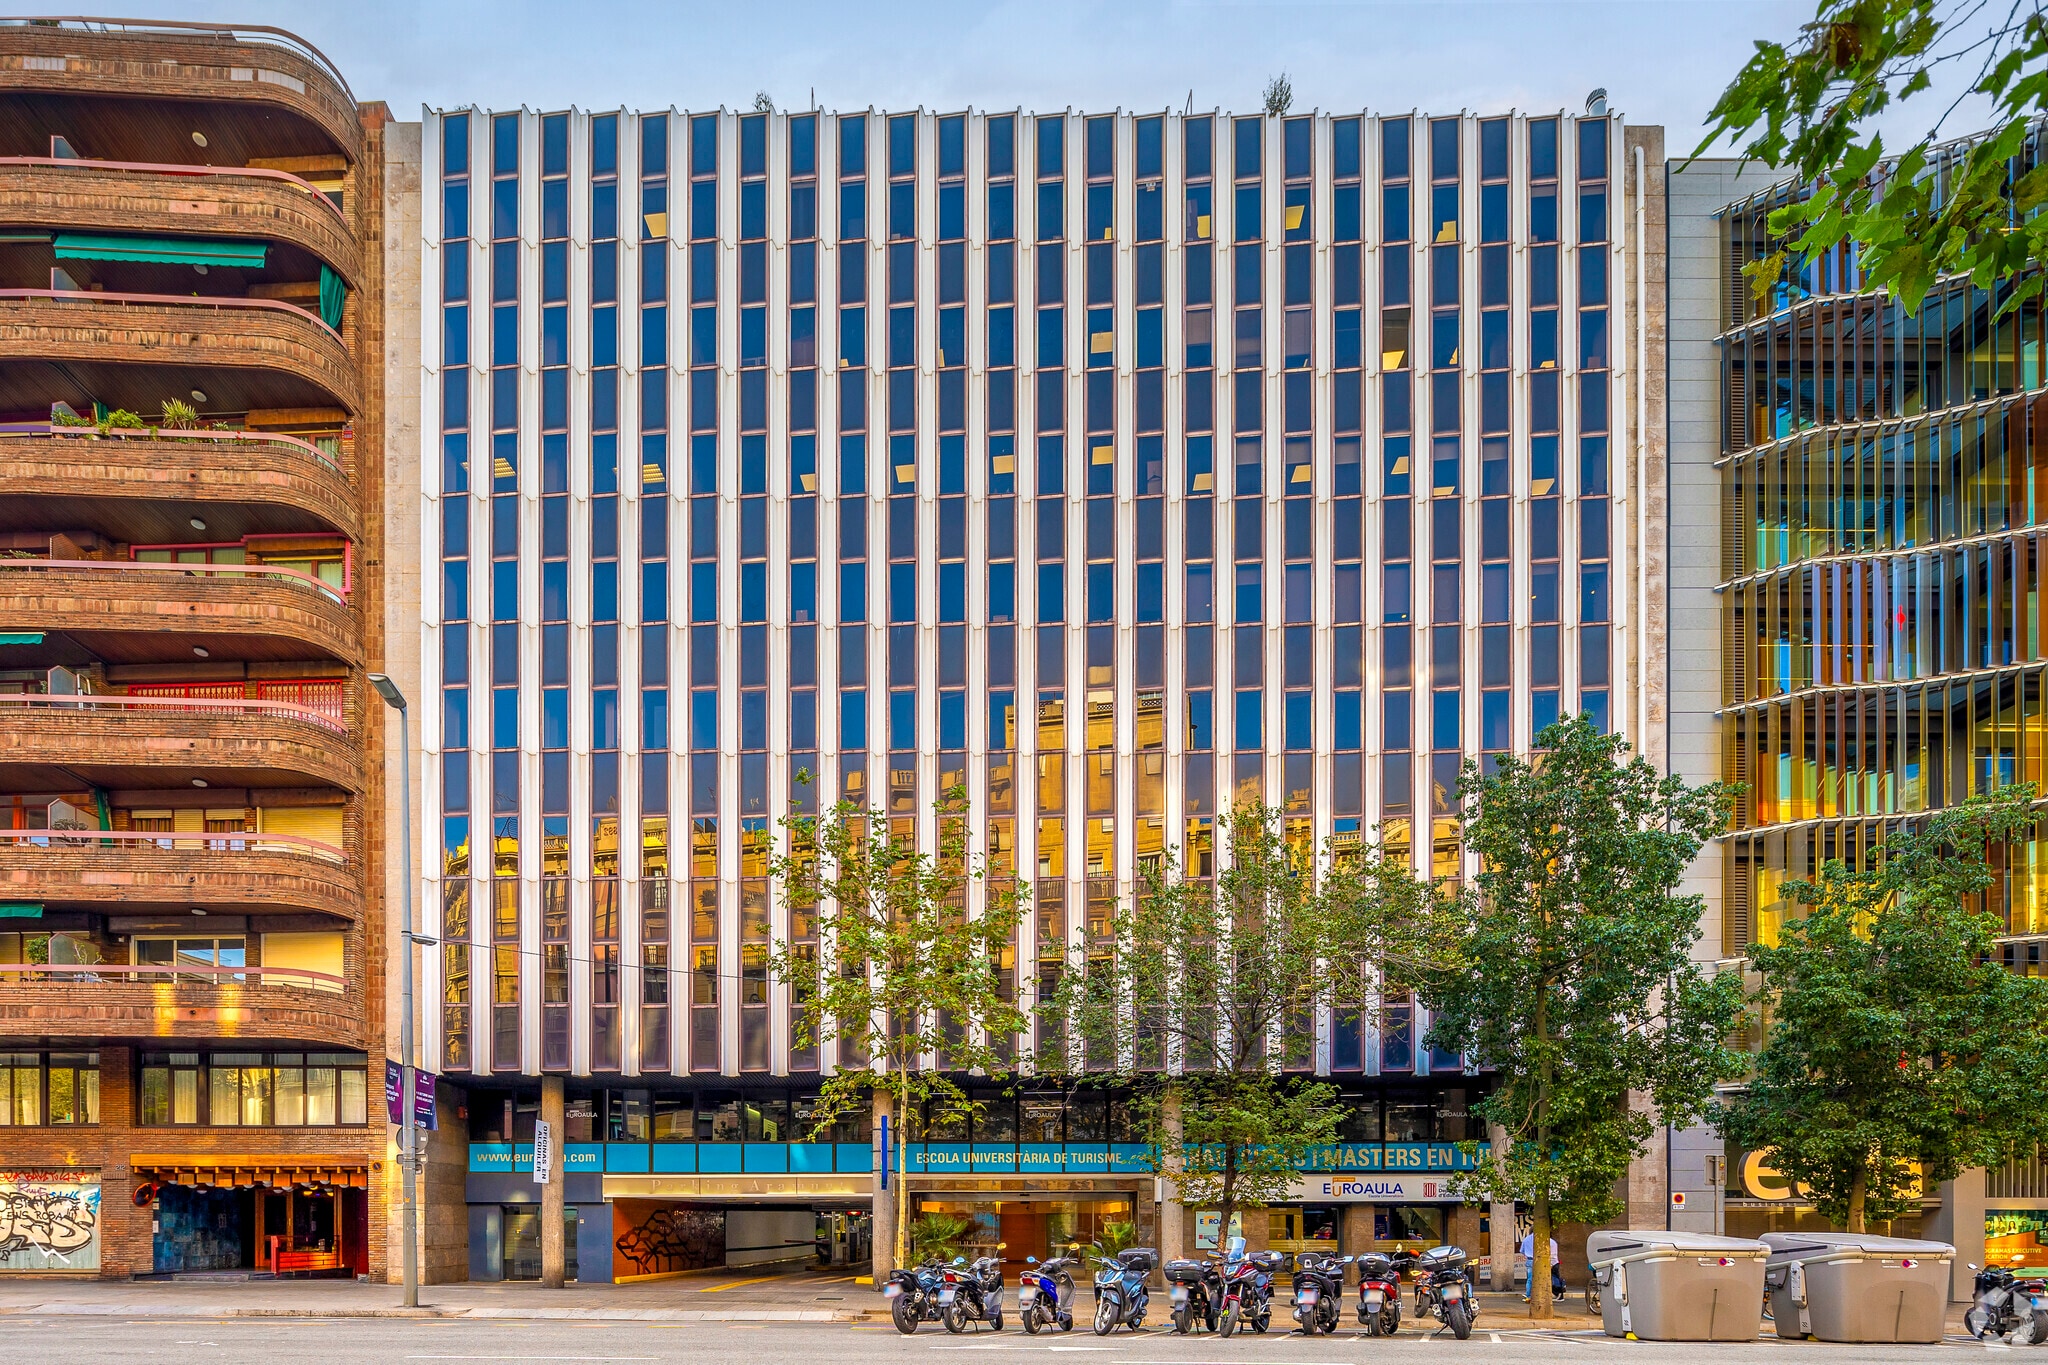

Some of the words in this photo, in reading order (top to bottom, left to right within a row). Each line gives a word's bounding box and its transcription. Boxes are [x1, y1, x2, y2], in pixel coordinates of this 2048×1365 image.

[1437, 1110, 1467, 1118] EUROAULA
[916, 1152, 960, 1164] ESCOLA
[963, 1150, 1051, 1164] UNIVERSITÀRIA
[1053, 1153, 1068, 1164] DE
[1071, 1152, 1123, 1164] TURISME
[1323, 1145, 1421, 1167] MÀSTERS
[1428, 1149, 1452, 1167] EN
[1323, 1182, 1404, 1197] EUROAULA
